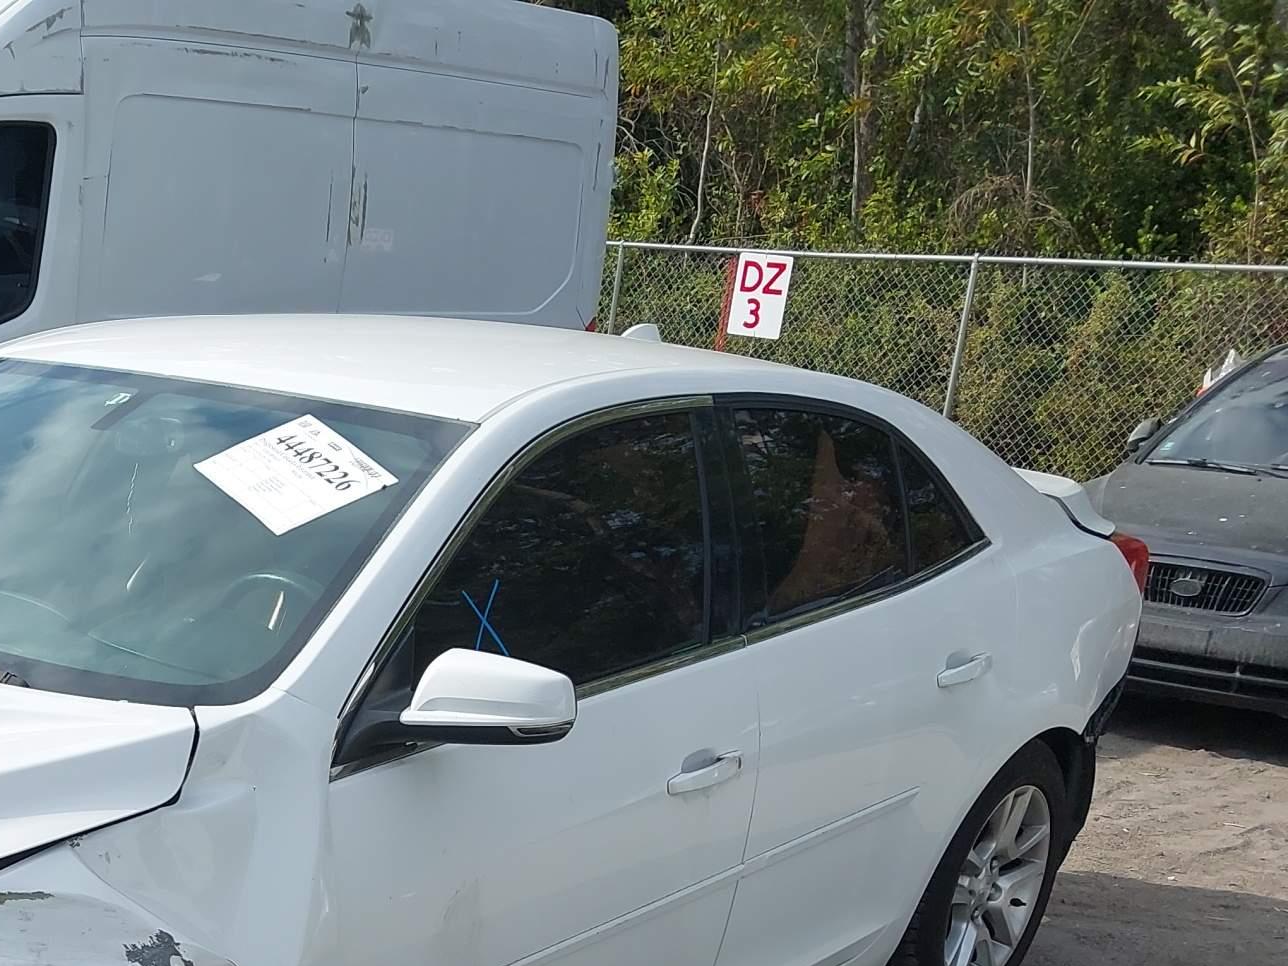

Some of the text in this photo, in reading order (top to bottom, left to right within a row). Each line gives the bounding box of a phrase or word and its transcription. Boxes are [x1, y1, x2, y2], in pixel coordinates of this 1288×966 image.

[739, 260, 787, 296] DZ
[742, 298, 760, 328] 3
[276, 434, 361, 491] 44487226
